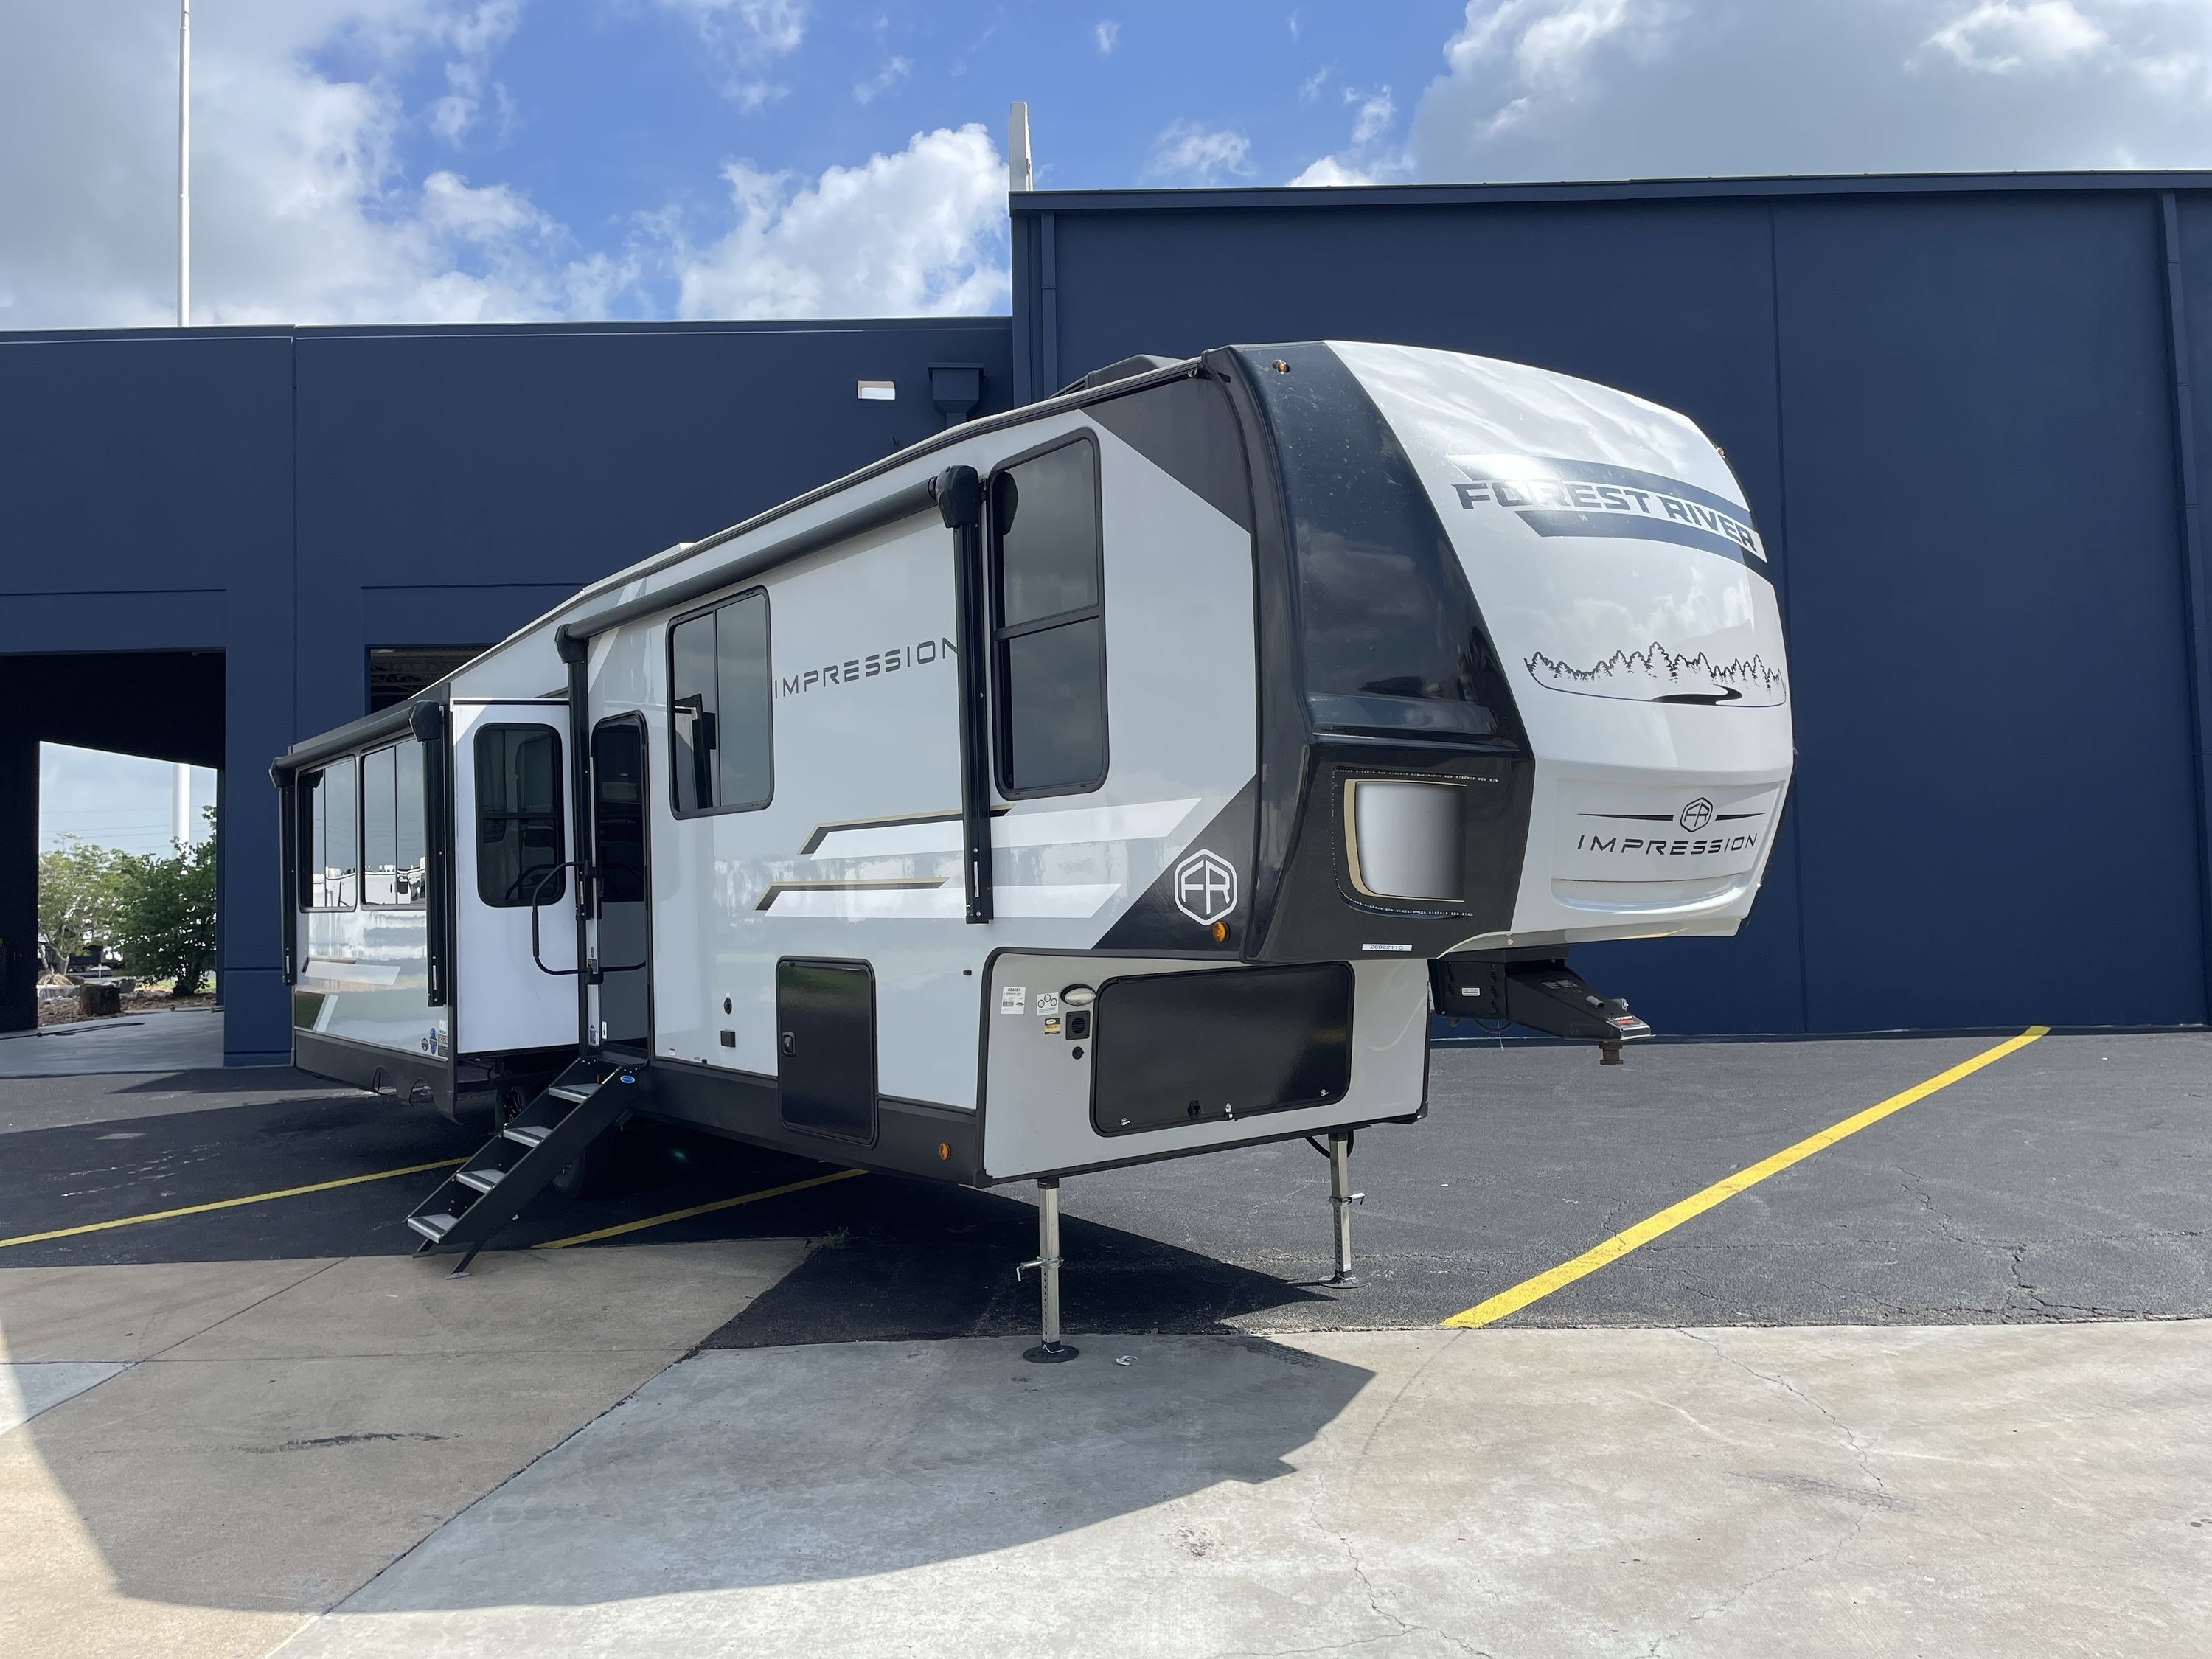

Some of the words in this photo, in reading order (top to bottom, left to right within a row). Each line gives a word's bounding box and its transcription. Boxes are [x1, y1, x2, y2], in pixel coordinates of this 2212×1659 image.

[1451, 480, 1652, 514] FOREST
[1657, 495, 1758, 553] RIVER
[1576, 833, 1758, 855] IMPRESSION
